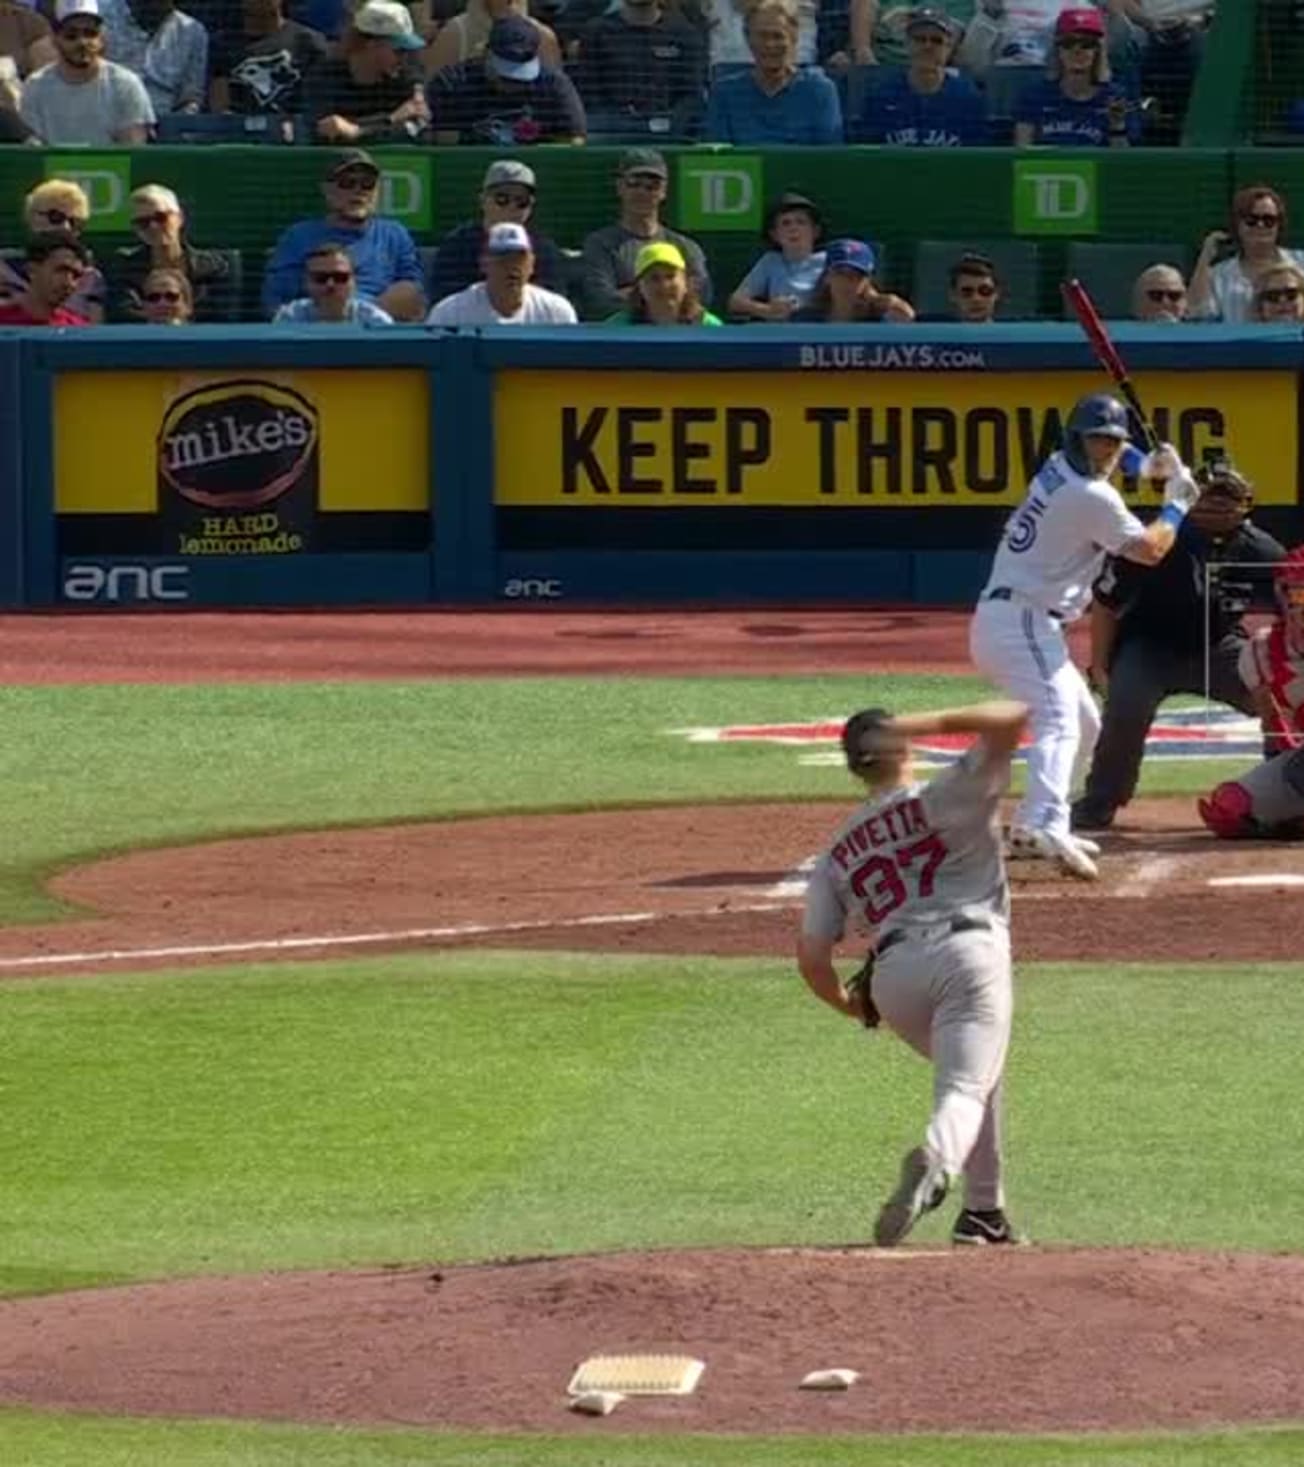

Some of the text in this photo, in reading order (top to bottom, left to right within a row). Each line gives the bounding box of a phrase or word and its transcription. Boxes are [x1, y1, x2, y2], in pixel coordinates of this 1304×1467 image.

[687, 169, 754, 215] TD
[1021, 173, 1090, 219] TD
[800, 344, 985, 368] BLUEJAYS.COM
[165, 410, 308, 470] mike's
[561, 406, 1227, 494] KEEP THROWNG
[178, 532, 302, 555] lemonade
[202, 512, 279, 537] HARD
[831, 798, 929, 871] PIVETTA
[851, 830, 948, 925] 37
